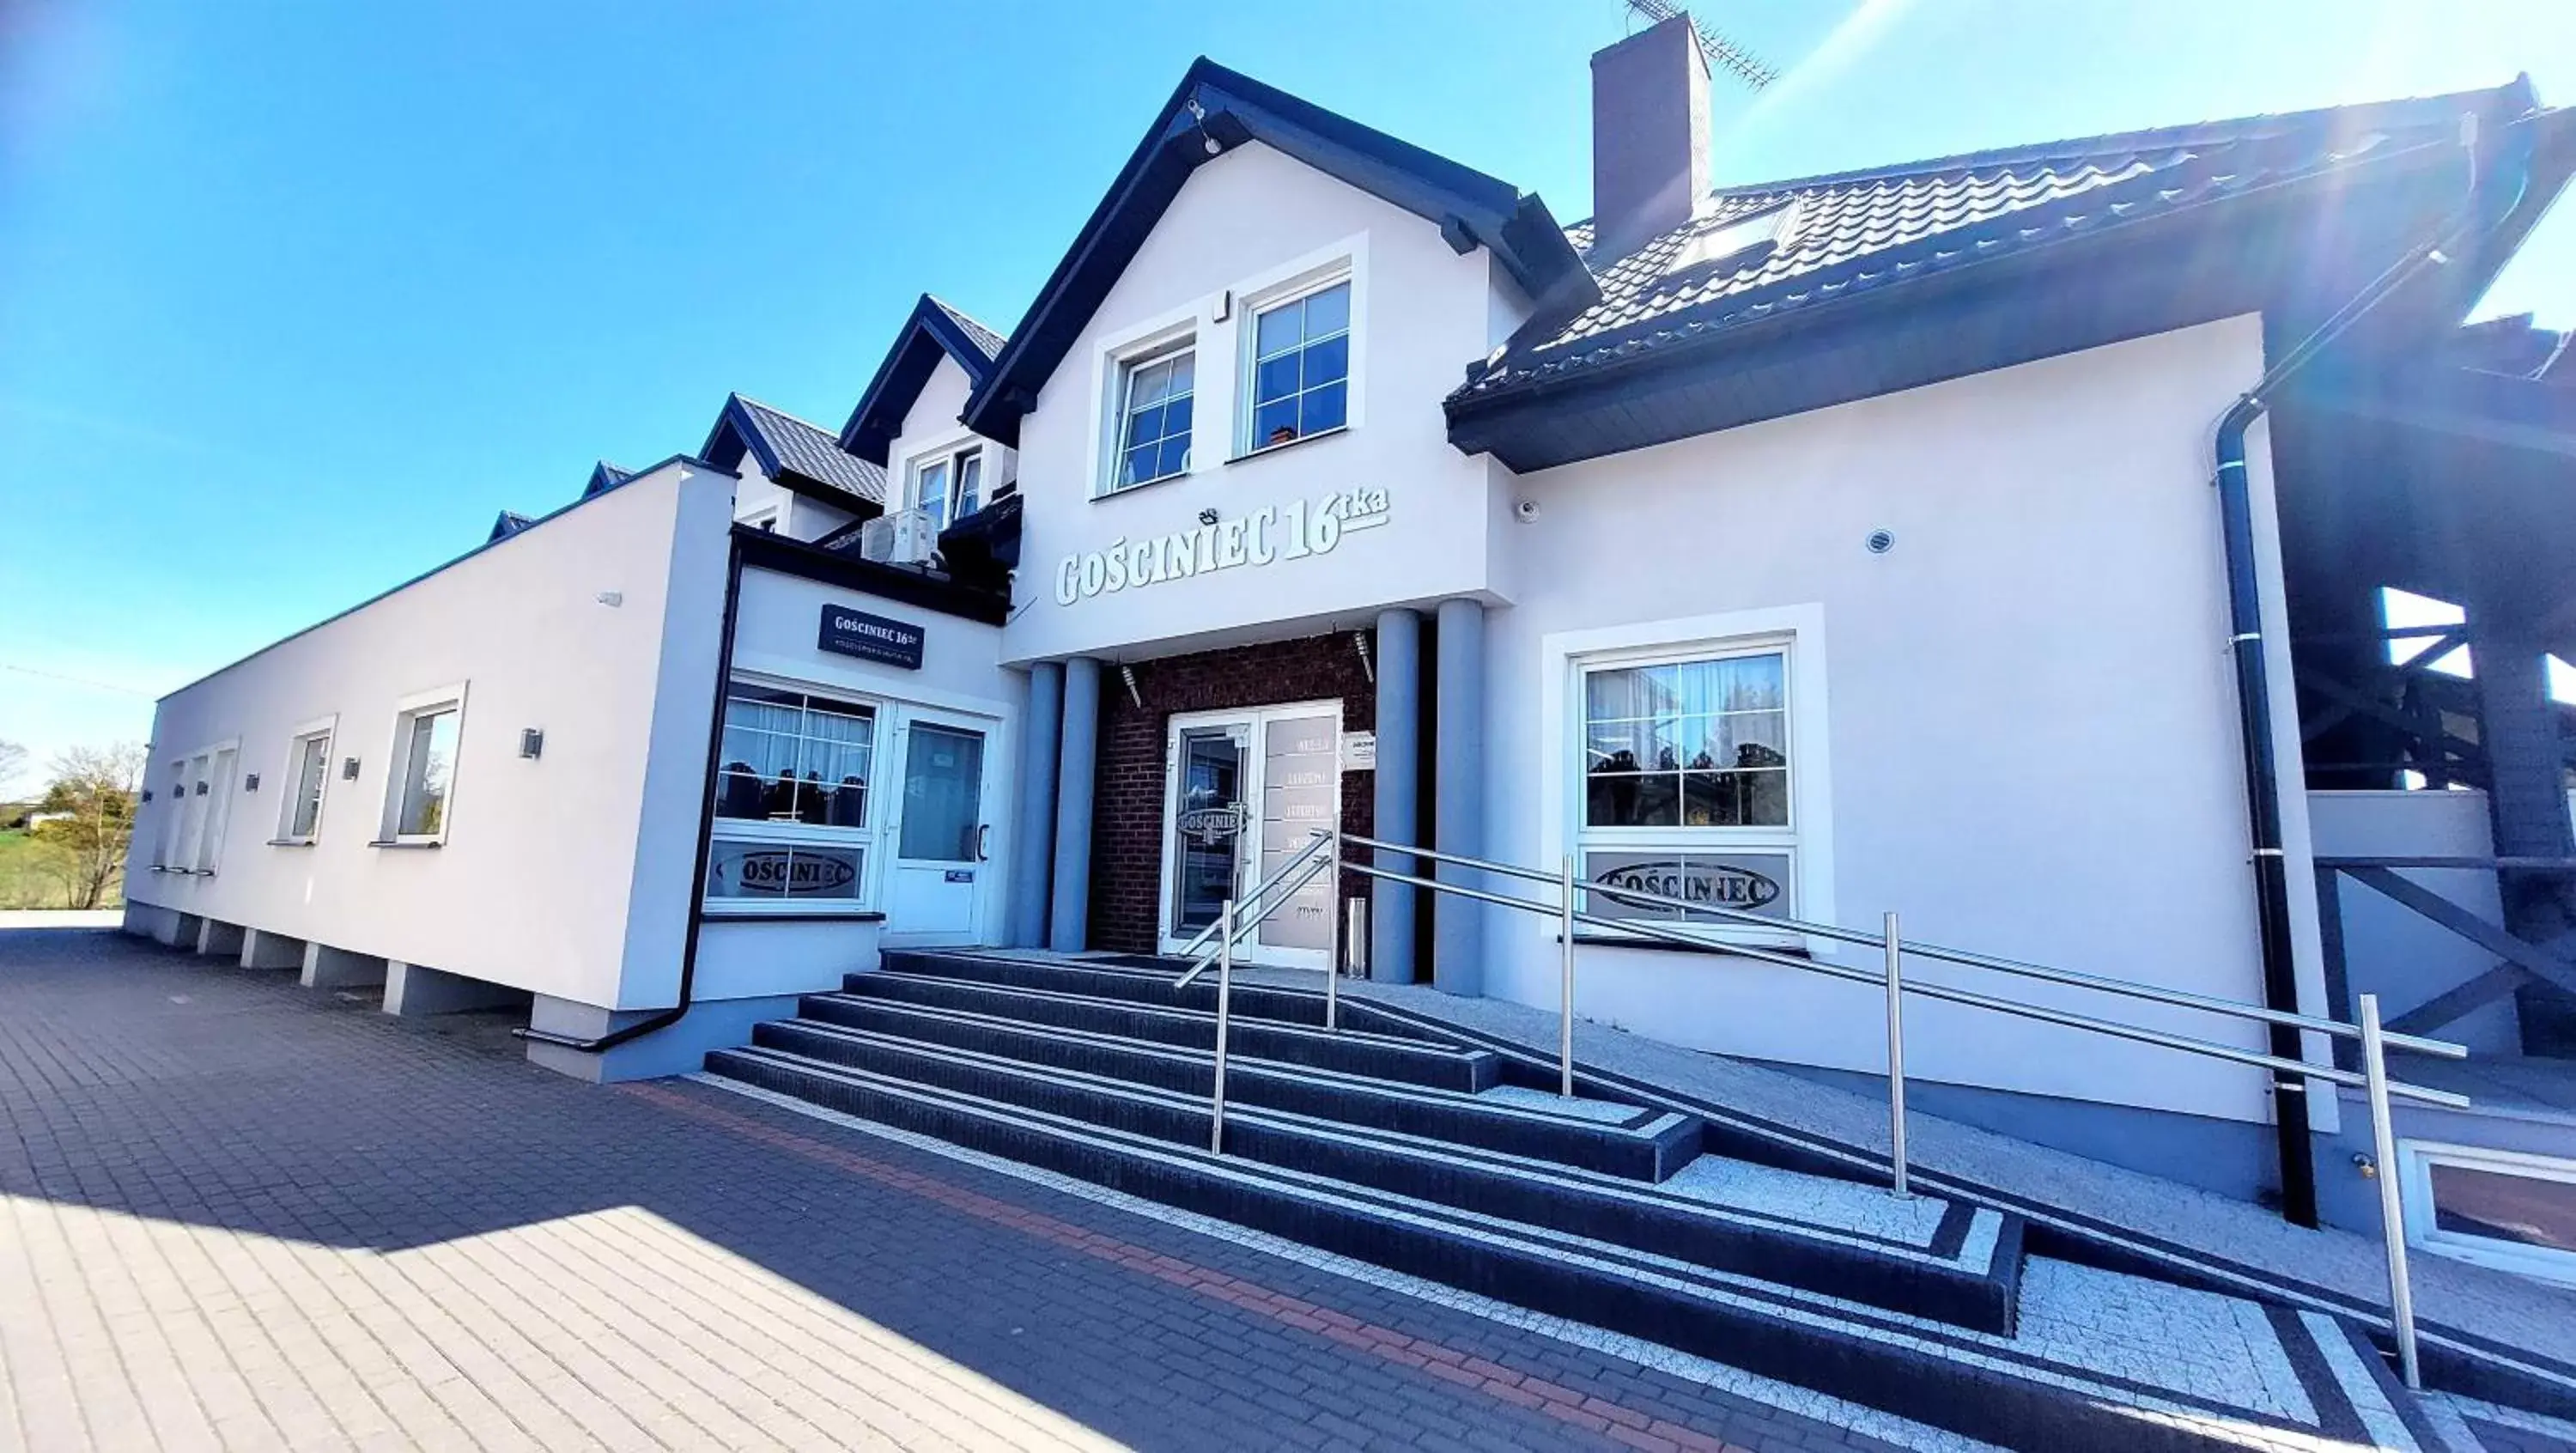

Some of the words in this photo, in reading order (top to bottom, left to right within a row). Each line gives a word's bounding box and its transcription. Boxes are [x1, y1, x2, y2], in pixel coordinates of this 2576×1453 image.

[1056, 505, 1277, 606] GOŚCINIEC
[835, 616, 896, 641] GOŚCINIEC
[742, 855, 853, 884] OŚCINIEC
